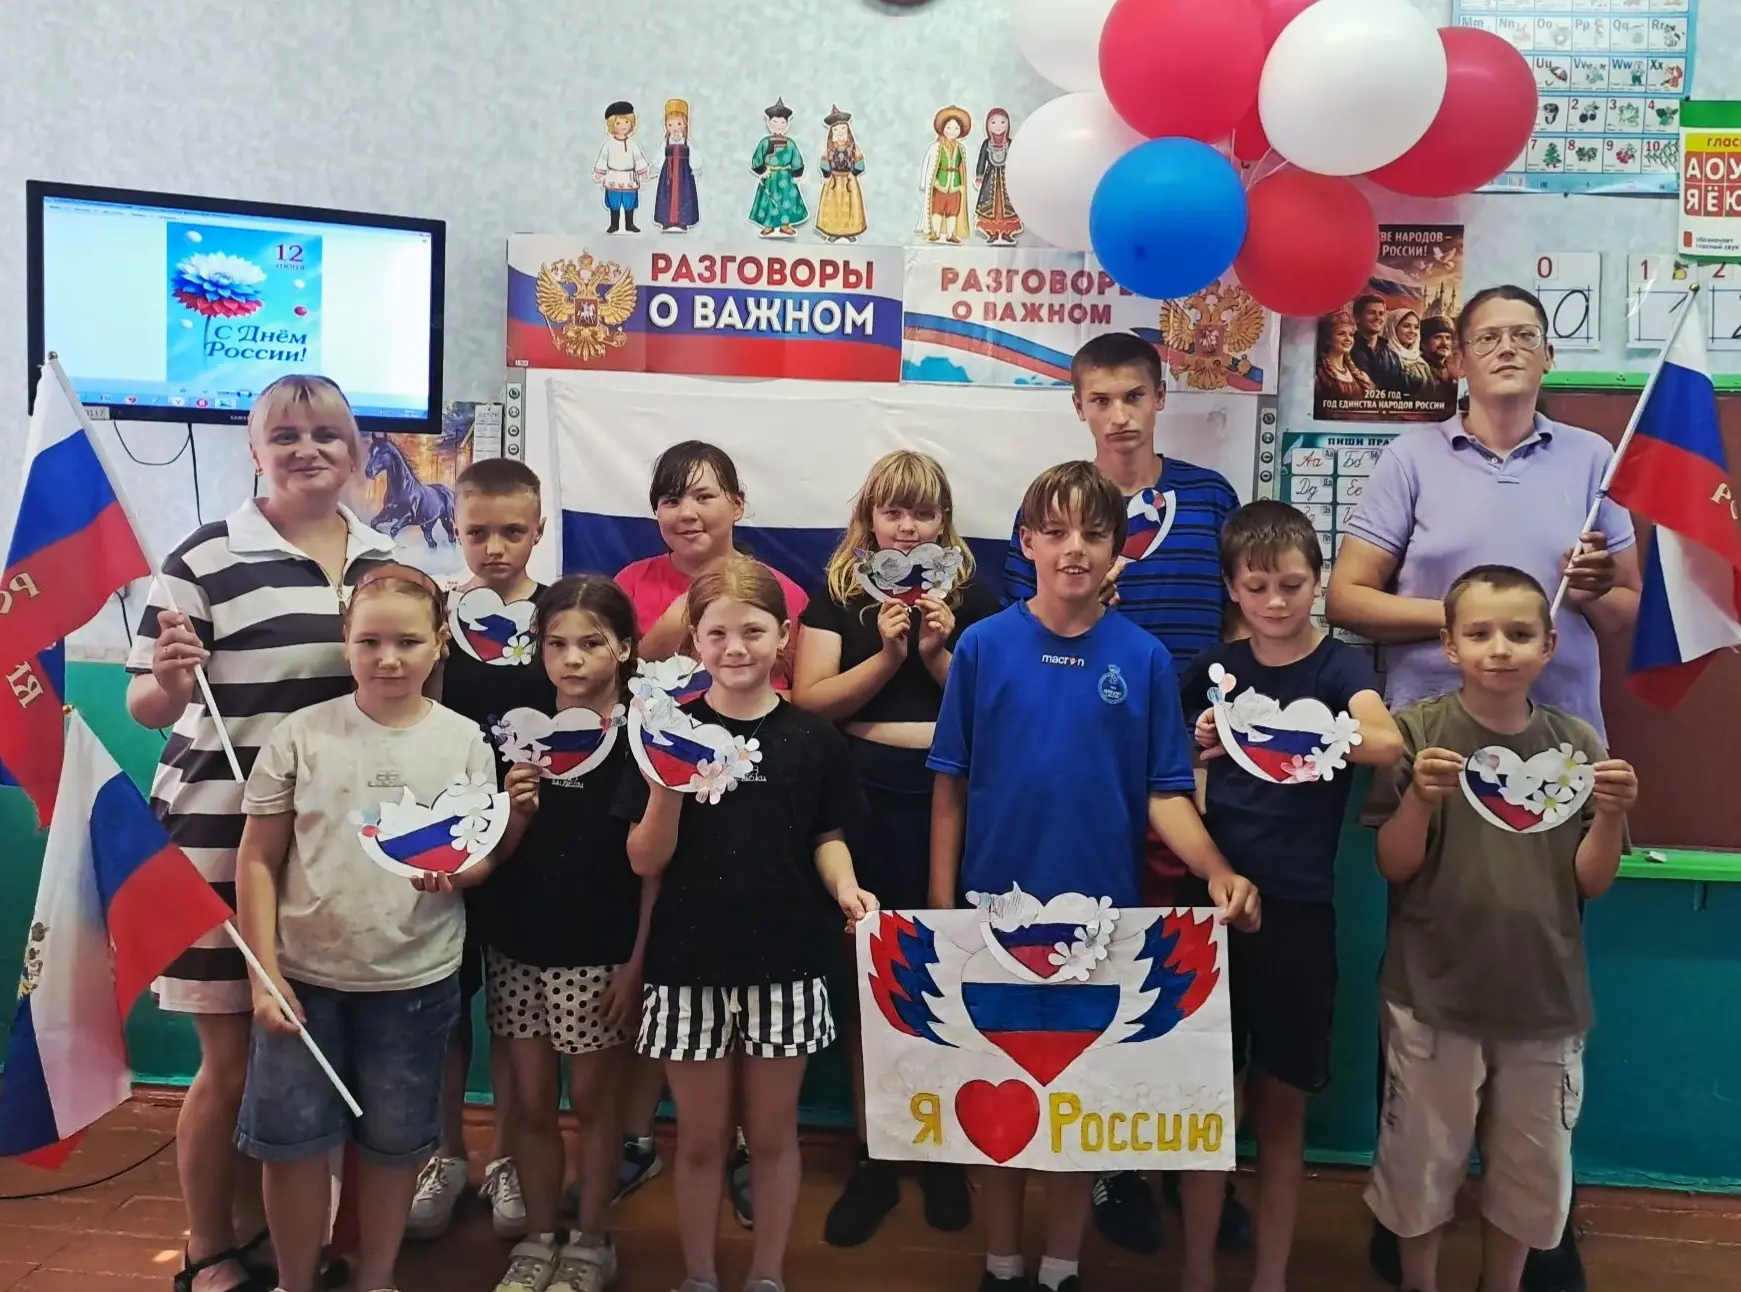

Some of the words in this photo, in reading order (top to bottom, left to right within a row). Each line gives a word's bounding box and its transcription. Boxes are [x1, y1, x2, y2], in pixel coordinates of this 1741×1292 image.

[1499, 18, 1515, 29] Nn
[1537, 18, 1552, 29] Oo
[1575, 19, 1590, 32] Pp
[1612, 19, 1630, 32] Qq
[1651, 20, 1664, 30] Rr
[1536, 58, 1552, 69] Uu
[1573, 58, 1587, 69] Vv
[1611, 59, 1633, 70] Ww
[1649, 59, 1664, 71] Xx
[1571, 98, 1579, 110] 2
[1609, 99, 1617, 110] 3
[1648, 100, 1655, 110] 4
[1530, 139, 1538, 150] 7
[1567, 139, 1576, 151] 8
[1606, 140, 1614, 151] 9
[1645, 140, 1661, 151] 10
[1707, 136, 1741, 148] глас
[1686, 157, 1702, 180] А
[1705, 157, 1725, 180] О
[1686, 189, 1700, 211] Я
[1706, 186, 1720, 212] Ё
[1396, 231, 1444, 244] НАРОДОВ
[276, 243, 304, 262] 12
[650, 252, 874, 290] РАЗГОВОРЫ
[1537, 256, 1553, 278] 0
[1640, 260, 1649, 280] 1
[940, 266, 1134, 296] РАЗГОВОР
[649, 293, 679, 329] О
[693, 295, 875, 336] ВАЖНОМ
[952, 299, 972, 321] О
[984, 301, 1112, 325] ВАЖНОМ
[214, 325, 232, 340] С
[237, 325, 308, 345] Днём
[204, 341, 307, 362] России!
[1364, 389, 1386, 399] 2026
[1323, 399, 1338, 409] ГОД
[1339, 400, 1377, 409] ЕДИНСТВА
[1378, 401, 1413, 410] НАРОДОВ
[909, 1092, 943, 1146] Я
[1048, 1092, 1224, 1154] Россию
